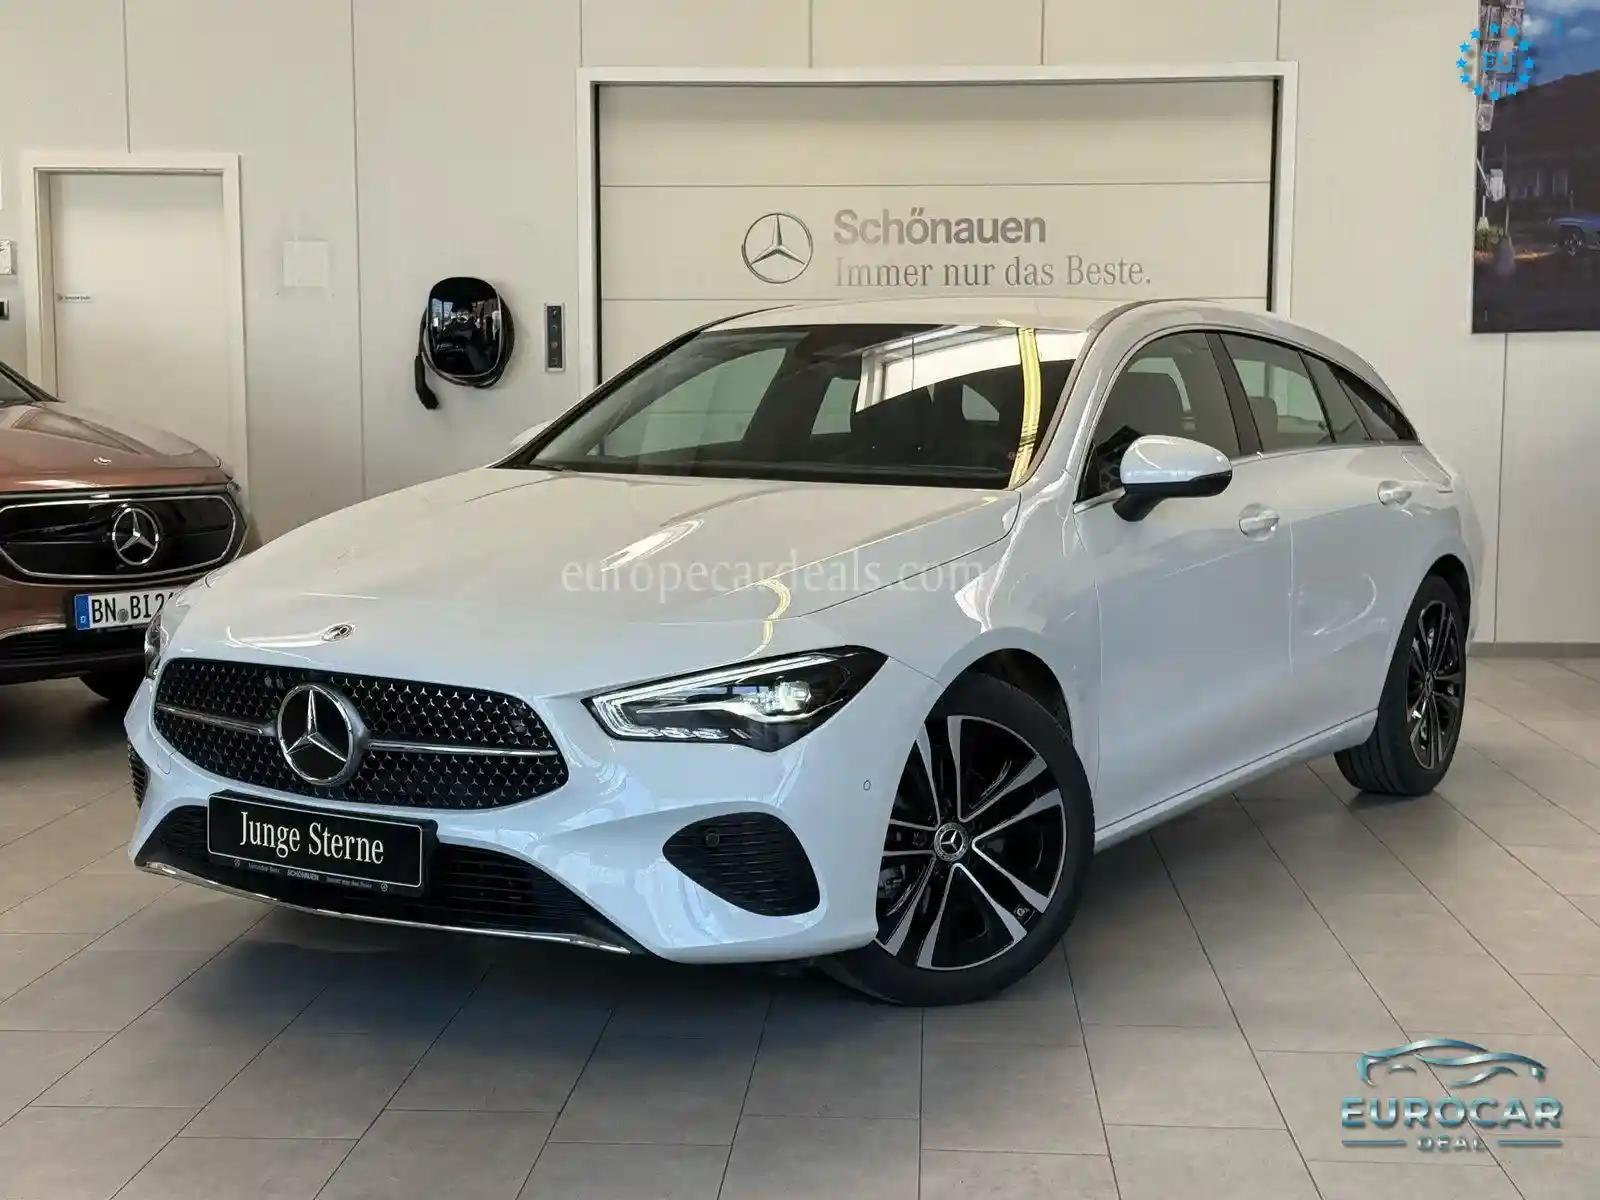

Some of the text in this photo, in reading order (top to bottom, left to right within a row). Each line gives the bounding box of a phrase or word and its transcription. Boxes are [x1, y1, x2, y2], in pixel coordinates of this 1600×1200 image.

[833, 207, 1047, 245] Schönauen
[835, 254, 1152, 288] Immer nur das Beste.
[91, 597, 117, 624] BN
[240, 811, 384, 864] Junge Sterne
